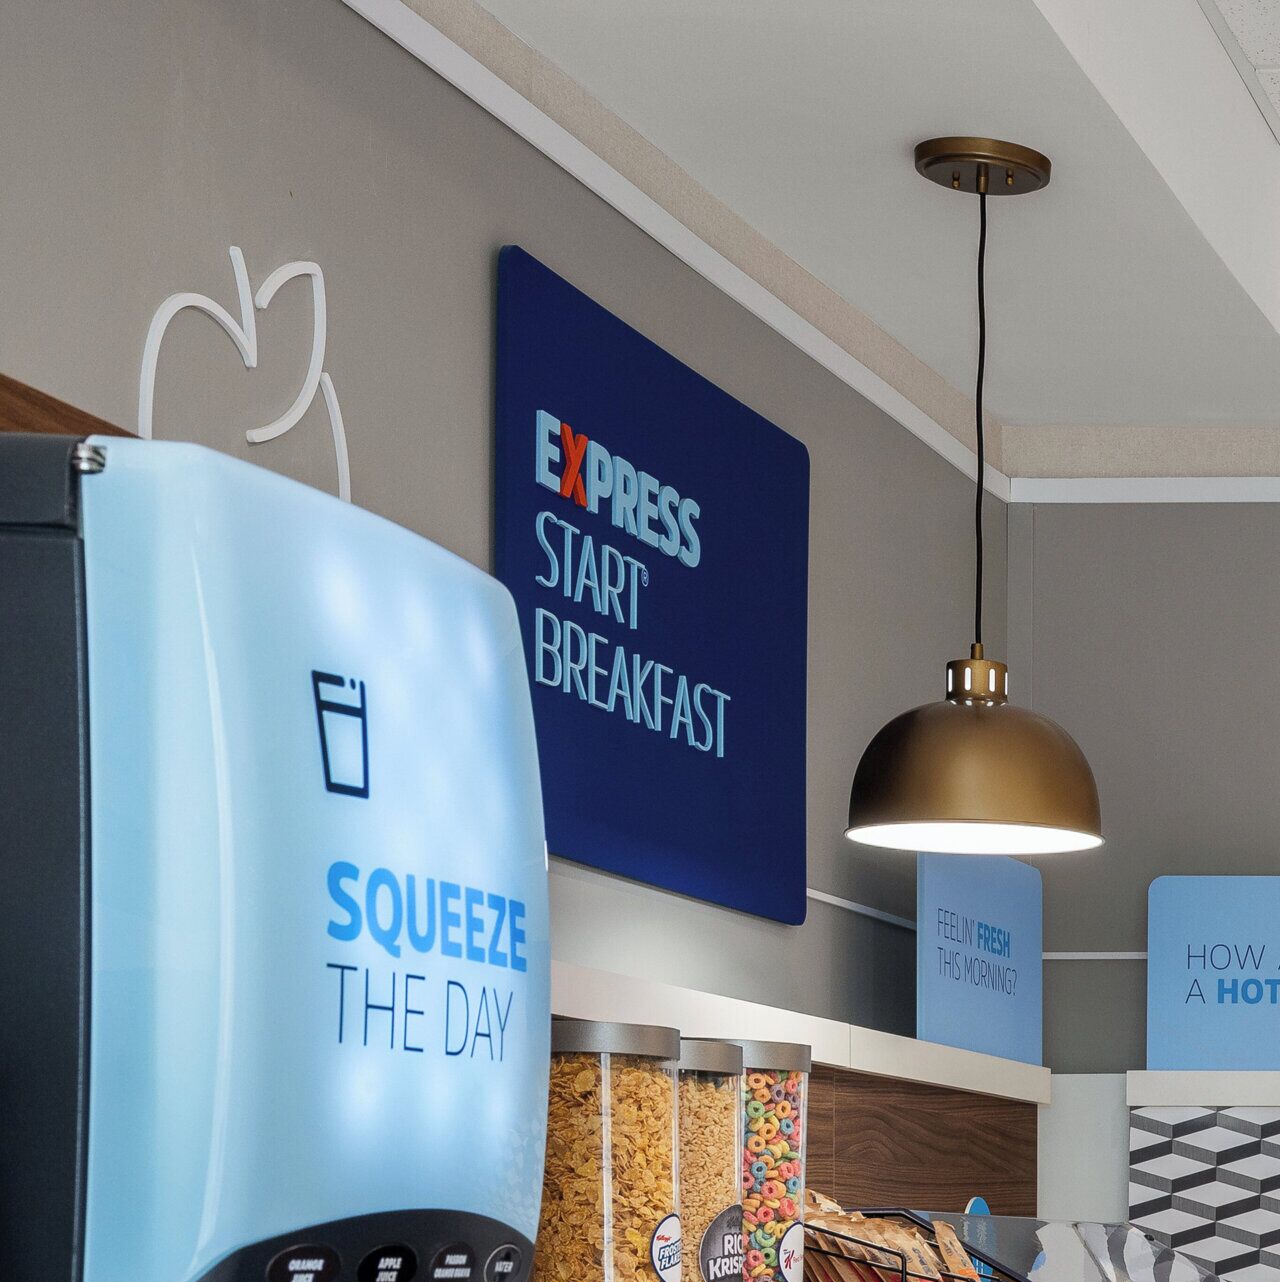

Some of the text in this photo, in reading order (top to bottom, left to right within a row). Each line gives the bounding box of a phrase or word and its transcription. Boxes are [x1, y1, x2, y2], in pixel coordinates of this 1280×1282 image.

[536, 409, 701, 568] EXPRESS
[536, 608, 730, 758] BREAKFAST
[327, 861, 527, 973] SQUEEZE
[937, 908, 1010, 958] FEELIN' FRESH
[937, 946, 1018, 996] THIS MORNING?
[1186, 944, 1266, 971] HOW
[327, 962, 513, 1062] THE DAY
[1185, 978, 1206, 1004] A
[376, 1271, 398, 1282] JUICE
[378, 1257, 402, 1269] APPLE
